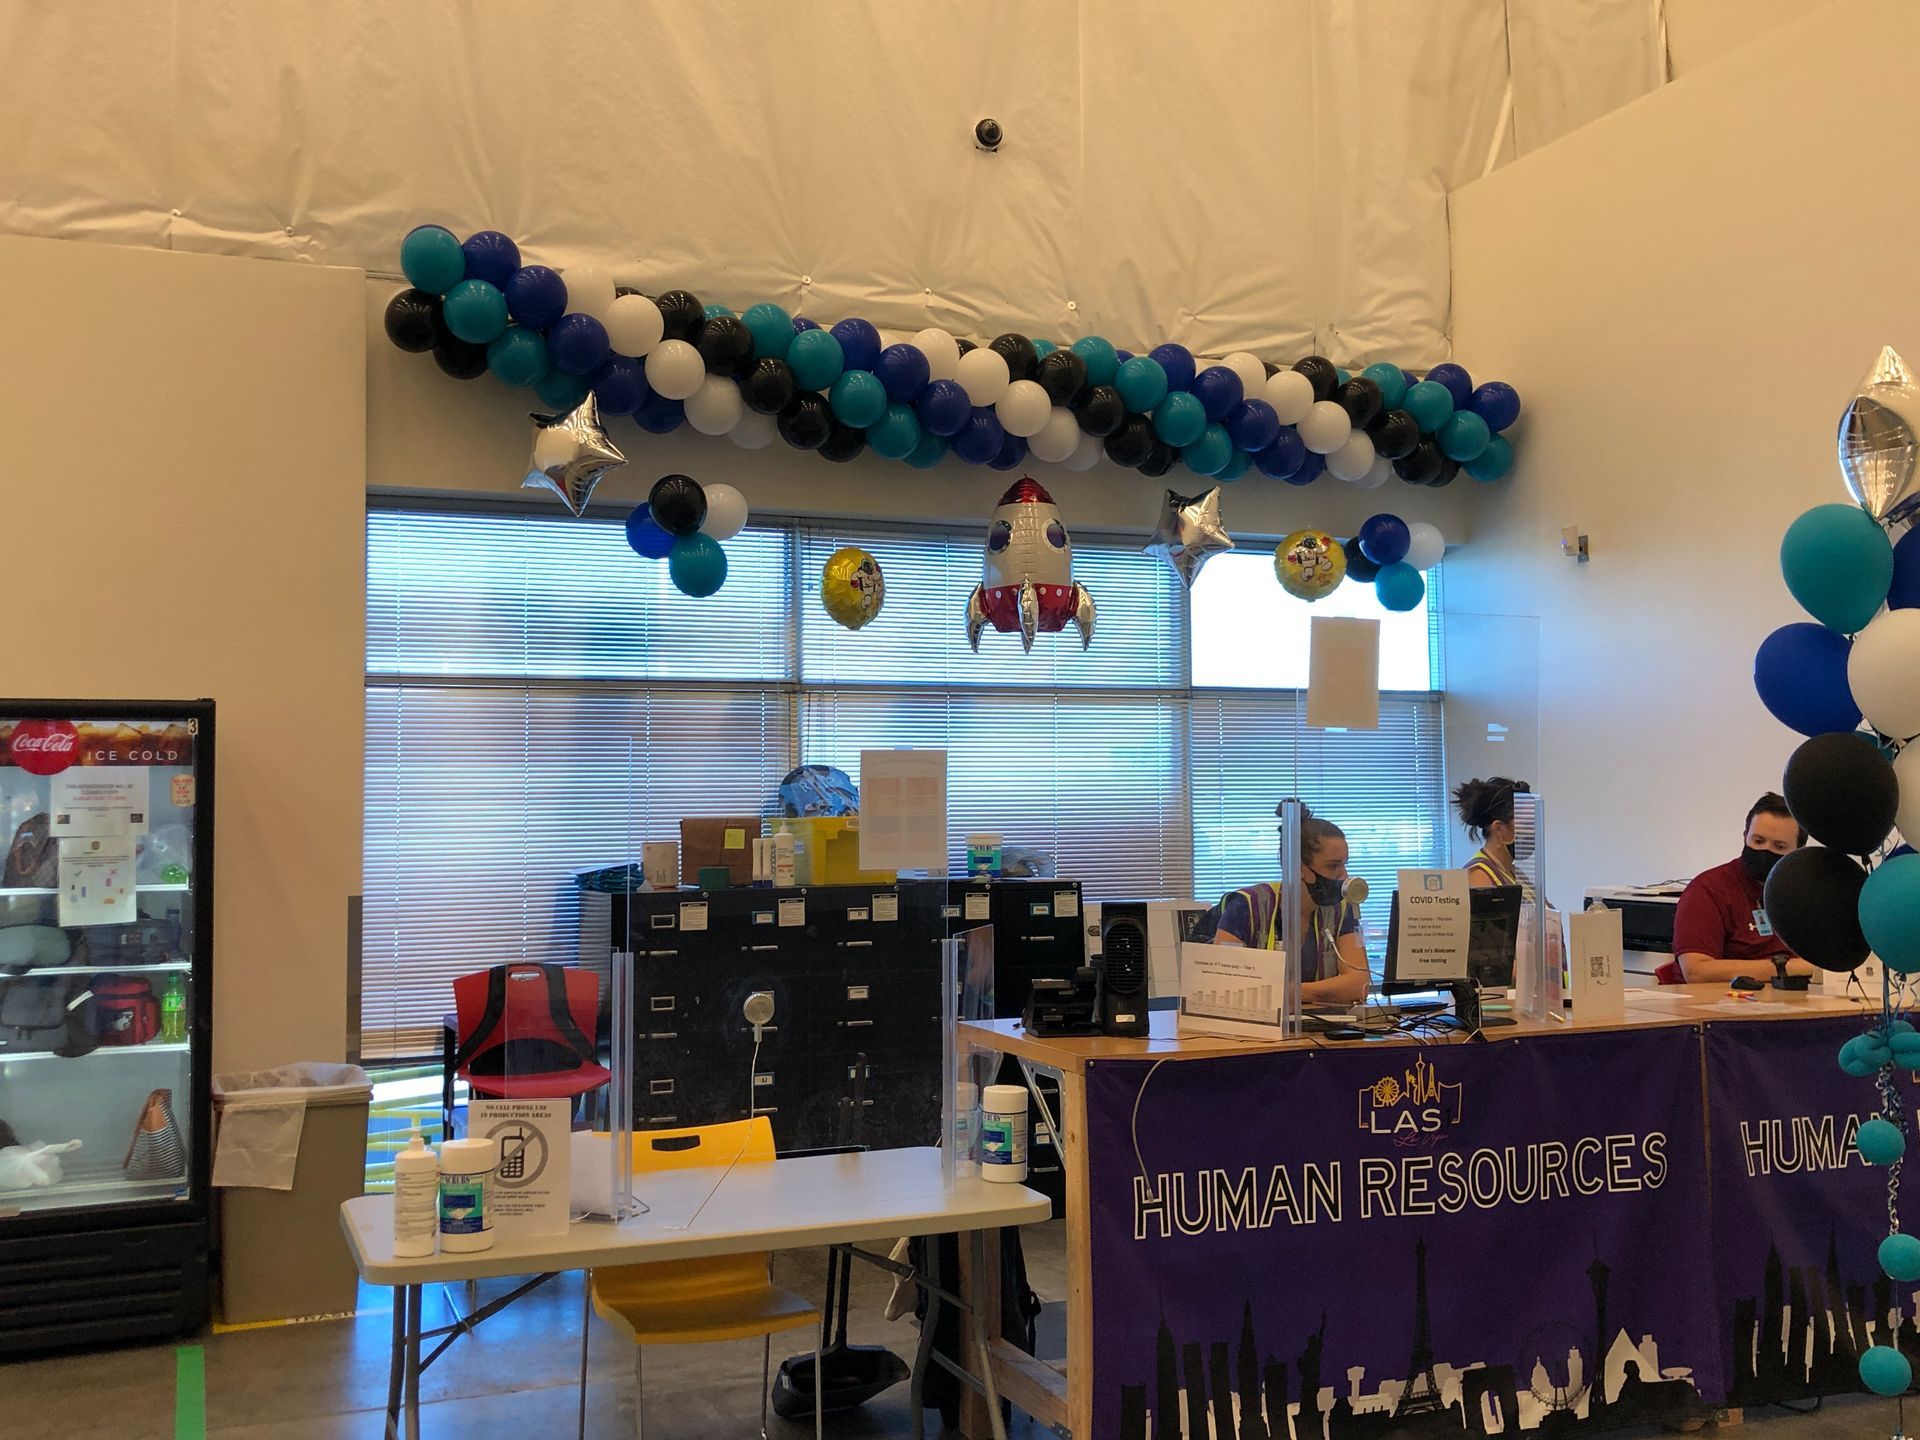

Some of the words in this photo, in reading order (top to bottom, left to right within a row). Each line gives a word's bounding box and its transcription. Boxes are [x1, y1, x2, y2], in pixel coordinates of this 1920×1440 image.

[189, 719, 197, 734] 3
[13, 733, 77, 752] Coca-Cola
[87, 750, 117, 761] ICE
[128, 750, 178, 761] COLD
[1410, 896, 1433, 904] COVID
[1435, 896, 1460, 905] Testing
[1739, 1112, 1904, 1177] HUMA
[1133, 1161, 1342, 1240] HUMAN
[1359, 1132, 1668, 1219] RESOURCES
